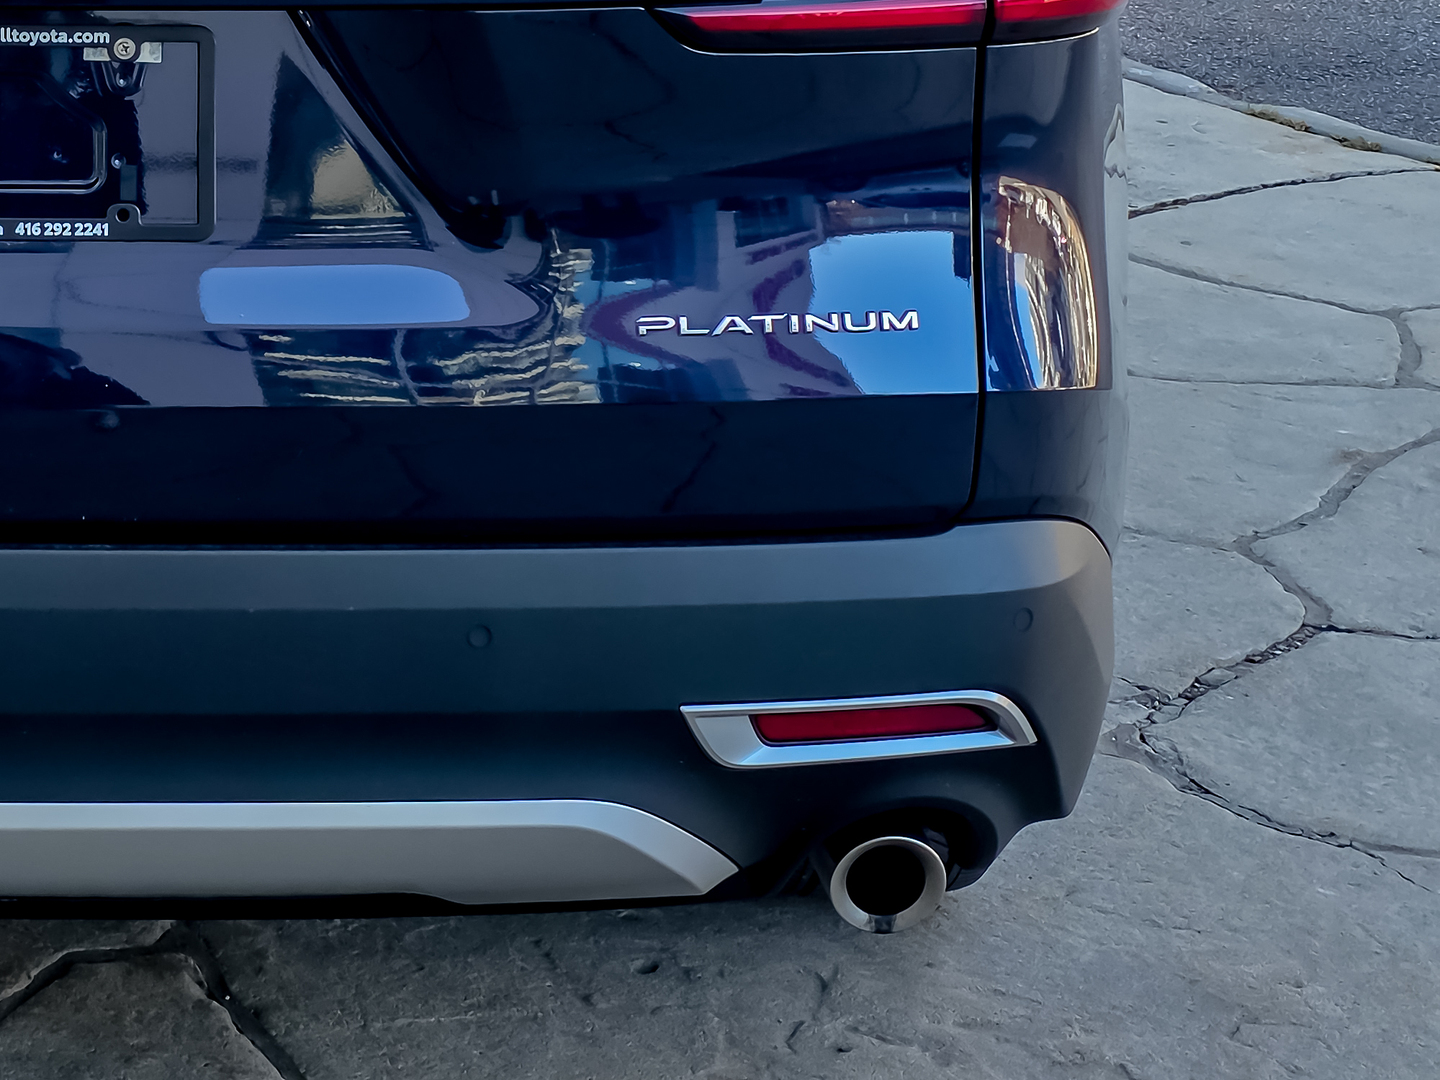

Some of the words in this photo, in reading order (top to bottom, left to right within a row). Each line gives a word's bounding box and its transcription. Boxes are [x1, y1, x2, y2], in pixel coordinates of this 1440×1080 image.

[15, 222, 42, 236] 416
[43, 222, 72, 236] 292
[74, 222, 110, 237] 2241
[635, 309, 921, 337] PLATINUM
